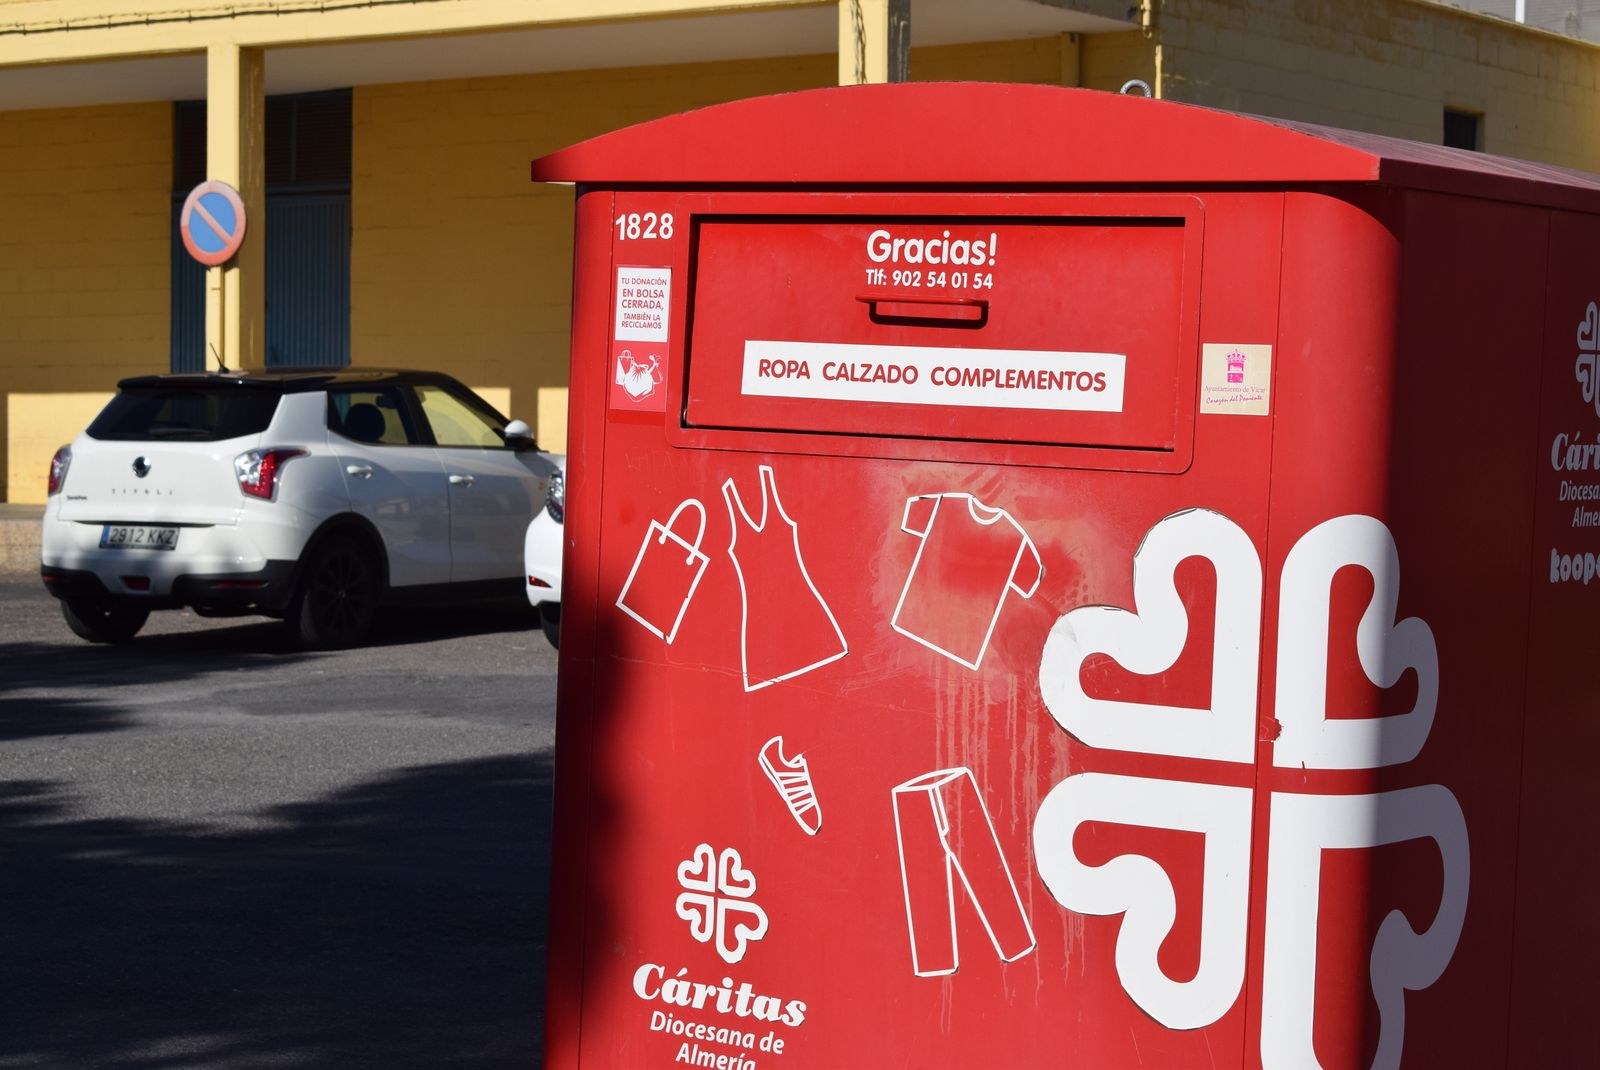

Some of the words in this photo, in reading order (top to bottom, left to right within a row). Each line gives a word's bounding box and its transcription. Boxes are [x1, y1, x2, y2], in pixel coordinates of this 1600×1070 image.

[615, 212, 674, 240] 1828
[866, 229, 997, 266] Gracias!
[621, 277, 630, 285] TU
[631, 276, 667, 286] DONACIÓN
[865, 268, 887, 286] Tlf:
[892, 270, 921, 287] 902
[926, 271, 947, 288] 54
[951, 272, 968, 288] 01
[972, 273, 993, 289] 54
[622, 288, 634, 298] EN
[636, 289, 665, 299] BOLSA
[621, 300, 664, 311] CERRADA,
[621, 321, 662, 330] RECICLAMOS
[623, 313, 651, 321] TAMBIÉN
[758, 359, 811, 379] ROPA
[822, 362, 919, 384] CALZADO
[930, 366, 1107, 392] COMPLEMENTOS
[1559, 480, 1600, 501] Diocesa
[109, 528, 145, 543] 2912
[147, 529, 176, 544] KKZ
[632, 963, 807, 1027] Cáritas
[650, 1010, 755, 1049] Diocesana
[759, 1031, 785, 1055] de
[675, 1042, 756, 1070] Almería
